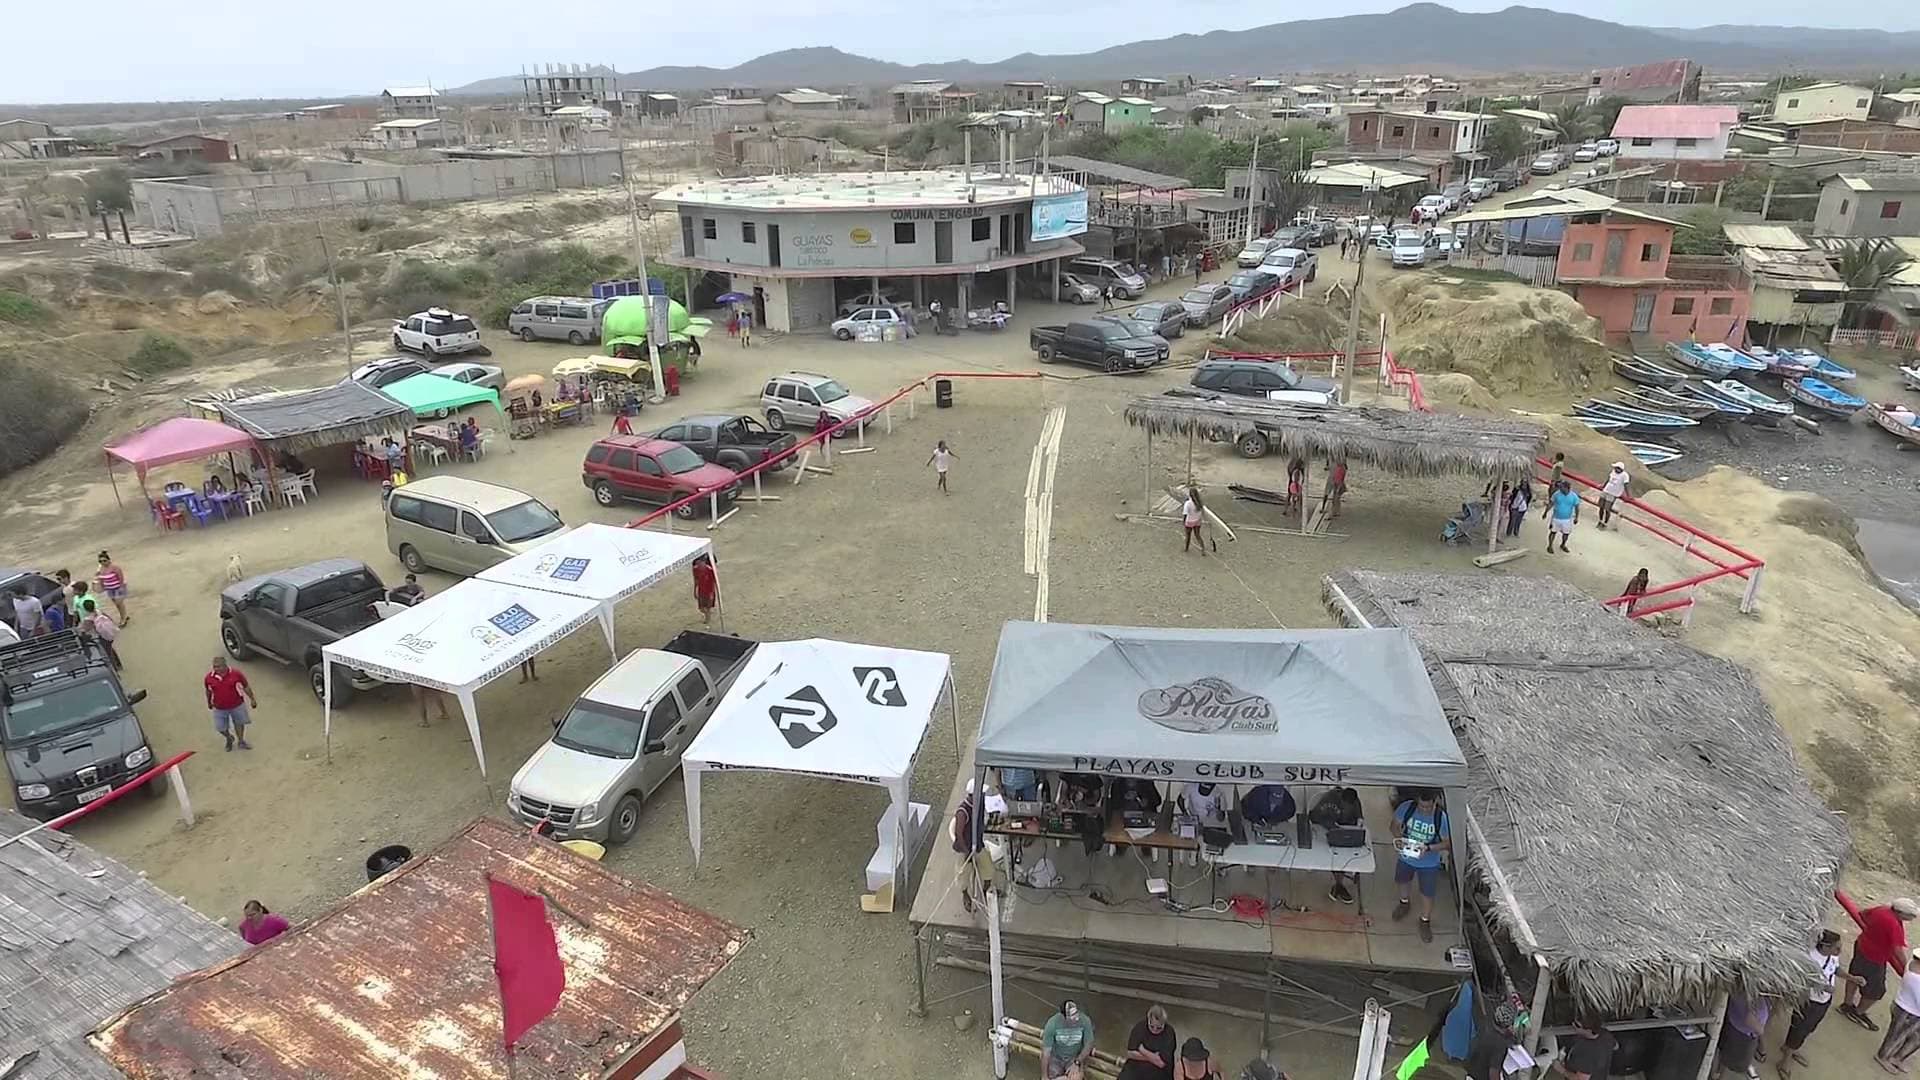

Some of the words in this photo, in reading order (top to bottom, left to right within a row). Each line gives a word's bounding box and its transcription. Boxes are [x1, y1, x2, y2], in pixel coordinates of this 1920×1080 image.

[890, 208, 934, 220] COMUNA
[792, 234, 833, 247] GUAYAS
[1152, 684, 1270, 729] Playas
[1072, 756, 1175, 776] PLAYAS
[1195, 763, 1265, 779] CLUB
[1284, 766, 1352, 782] SURF
